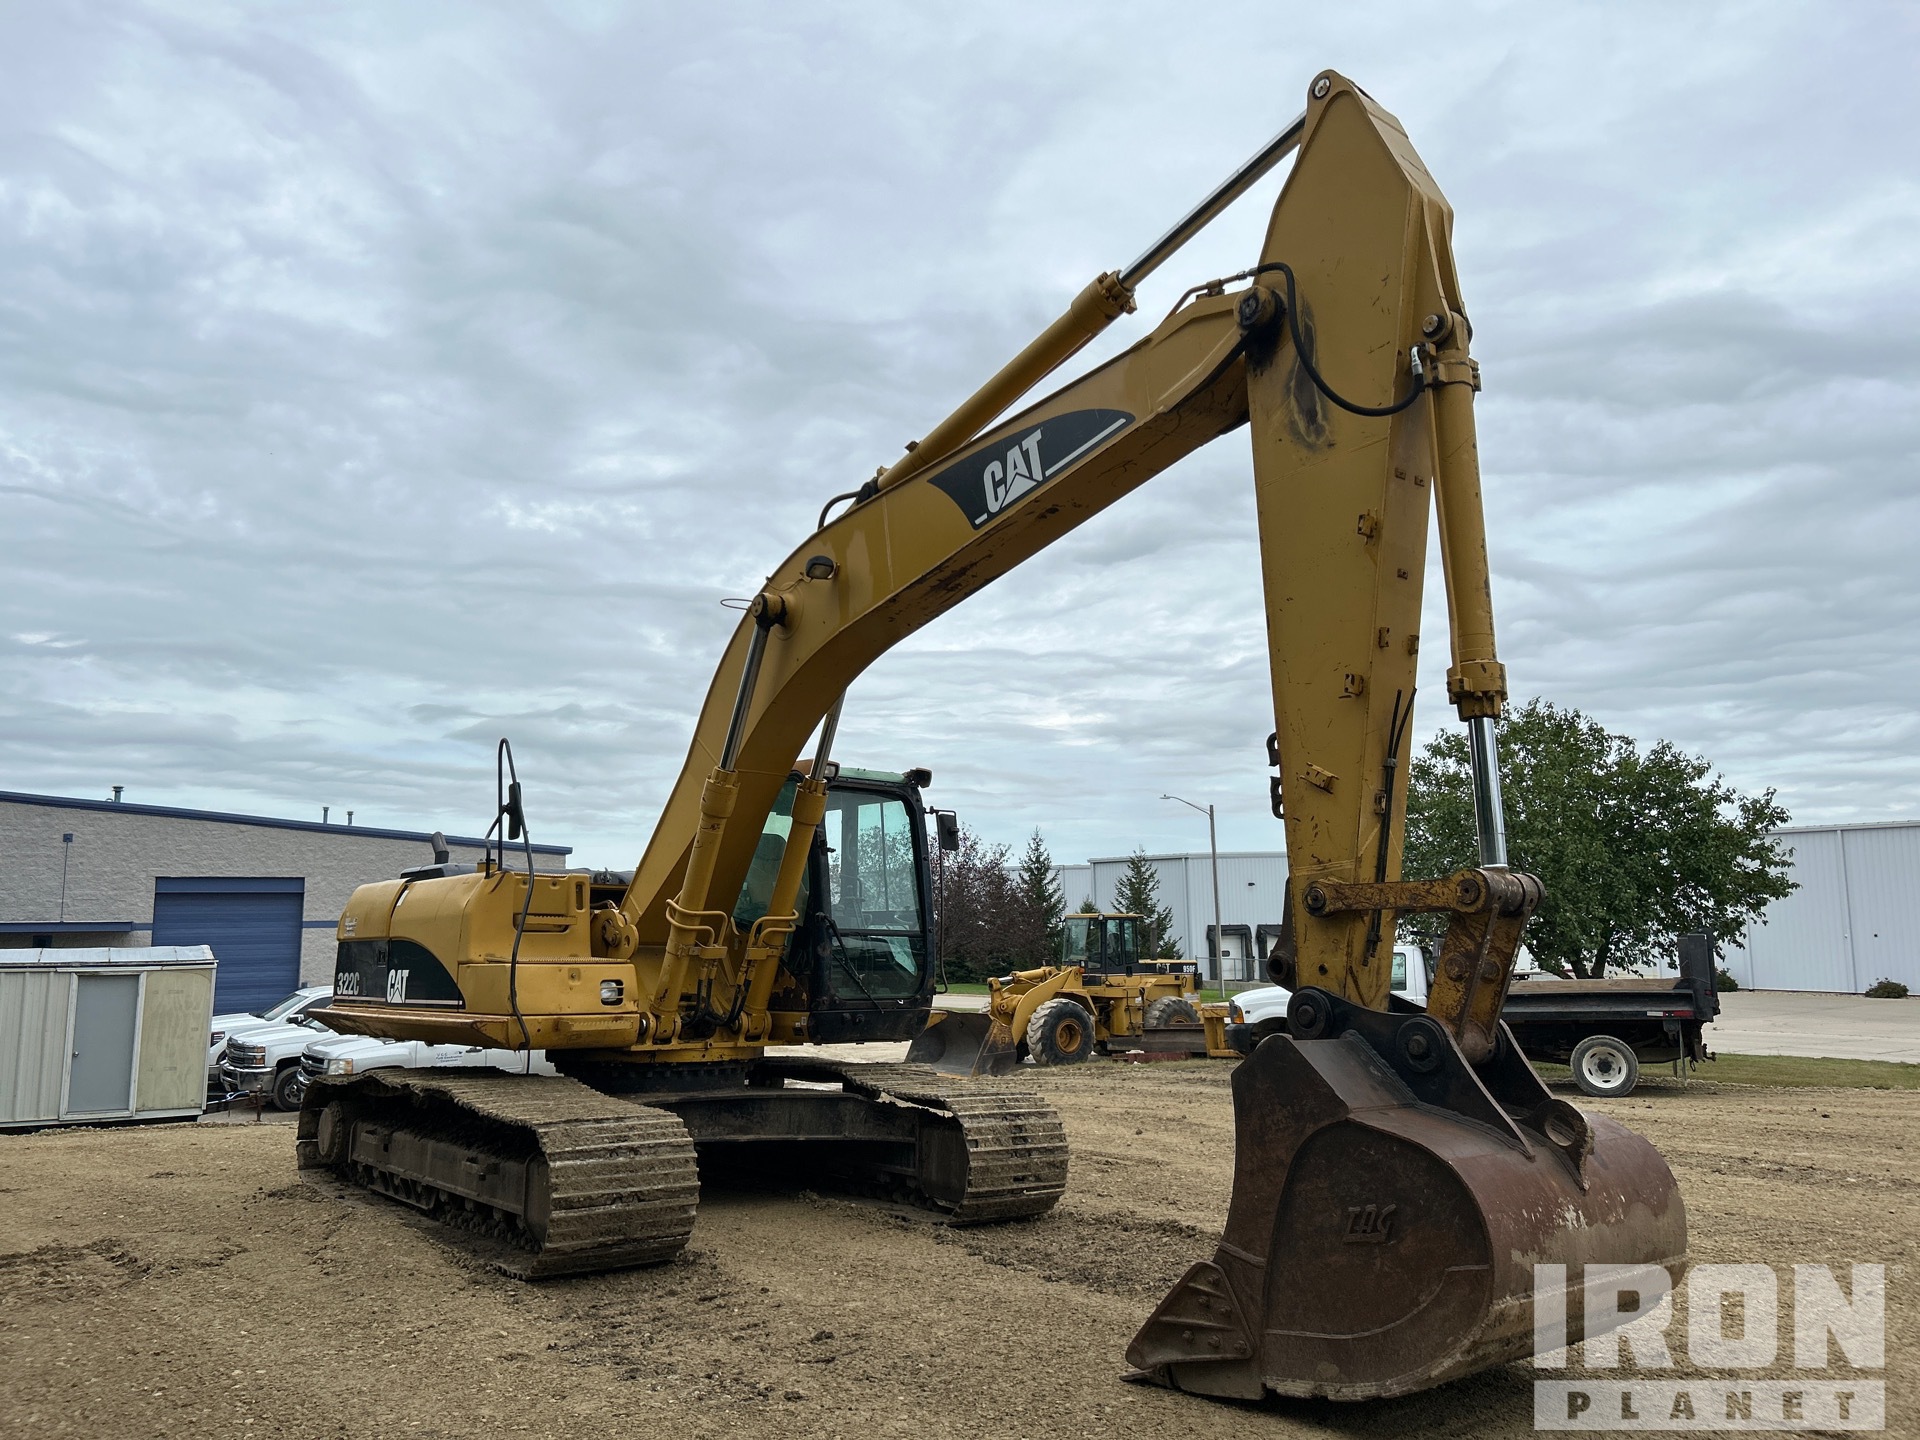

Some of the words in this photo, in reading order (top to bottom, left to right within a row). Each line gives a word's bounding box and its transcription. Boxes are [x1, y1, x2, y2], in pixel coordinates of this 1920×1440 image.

[983, 428, 1043, 513] CAT
[1183, 965, 1195, 973] 950F
[337, 972, 360, 995] 322C
[387, 969, 410, 1003] CAT
